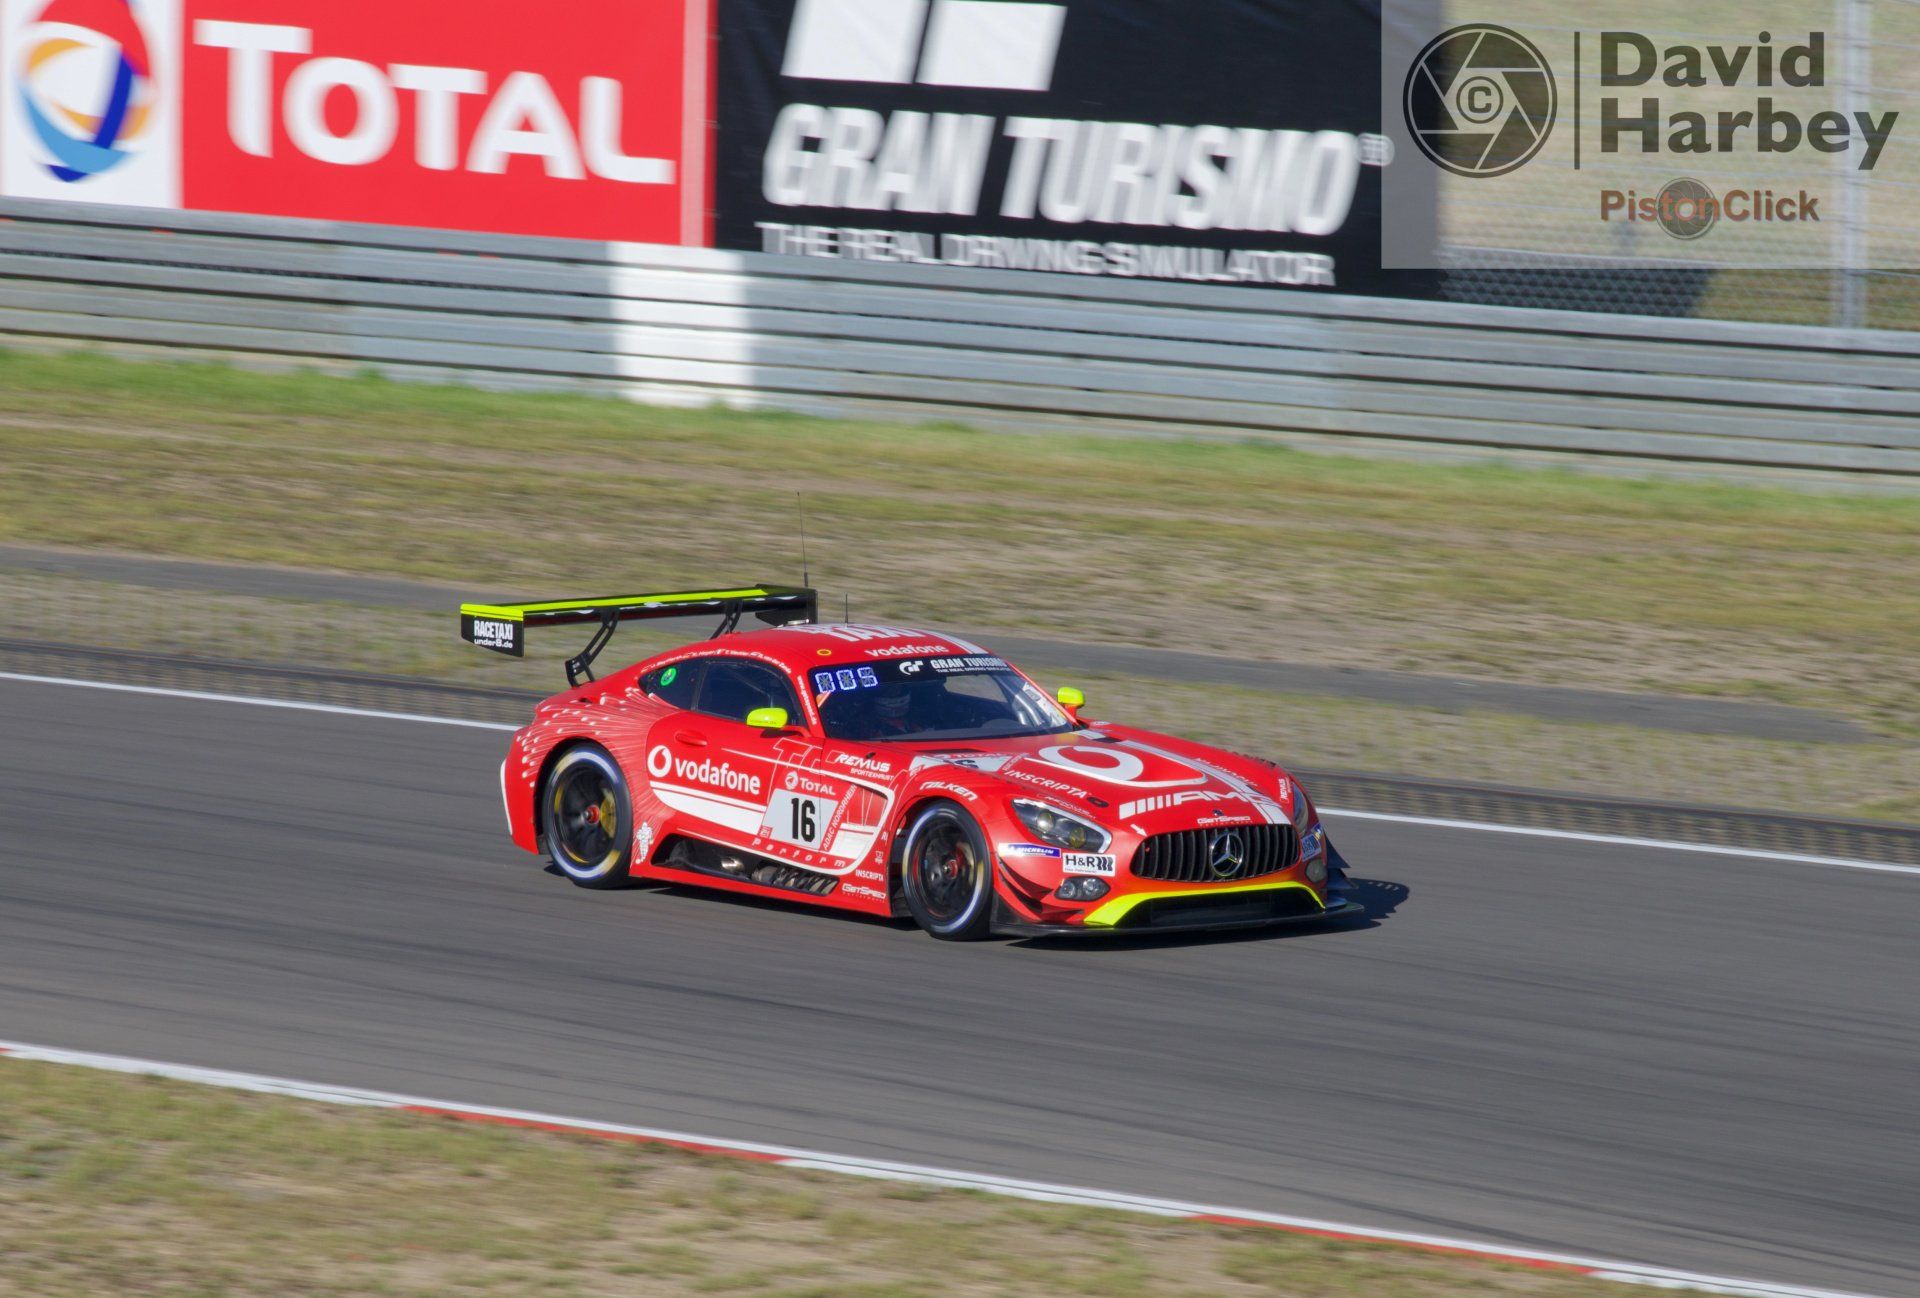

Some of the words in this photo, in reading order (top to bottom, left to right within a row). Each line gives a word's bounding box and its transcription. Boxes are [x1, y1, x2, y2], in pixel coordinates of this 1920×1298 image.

[194, 19, 674, 185] TOTAL
[762, 103, 995, 216] GRAN
[754, 221, 838, 259] THE
[837, 226, 941, 265] REAL
[474, 620, 513, 640] RACETAXI
[474, 638, 513, 648] under8.de
[865, 644, 949, 657] vodafone
[930, 658, 965, 669] GRAN
[834, 753, 891, 773] REMUS
[674, 758, 761, 795] vodafone
[800, 778, 836, 796] TOTAL
[1003, 769, 1088, 799] INSCRIPTA
[920, 781, 978, 802] FALKEN
[791, 797, 816, 843] 16
[822, 829, 835, 851] ADAC
[1065, 855, 1096, 868] H&R
